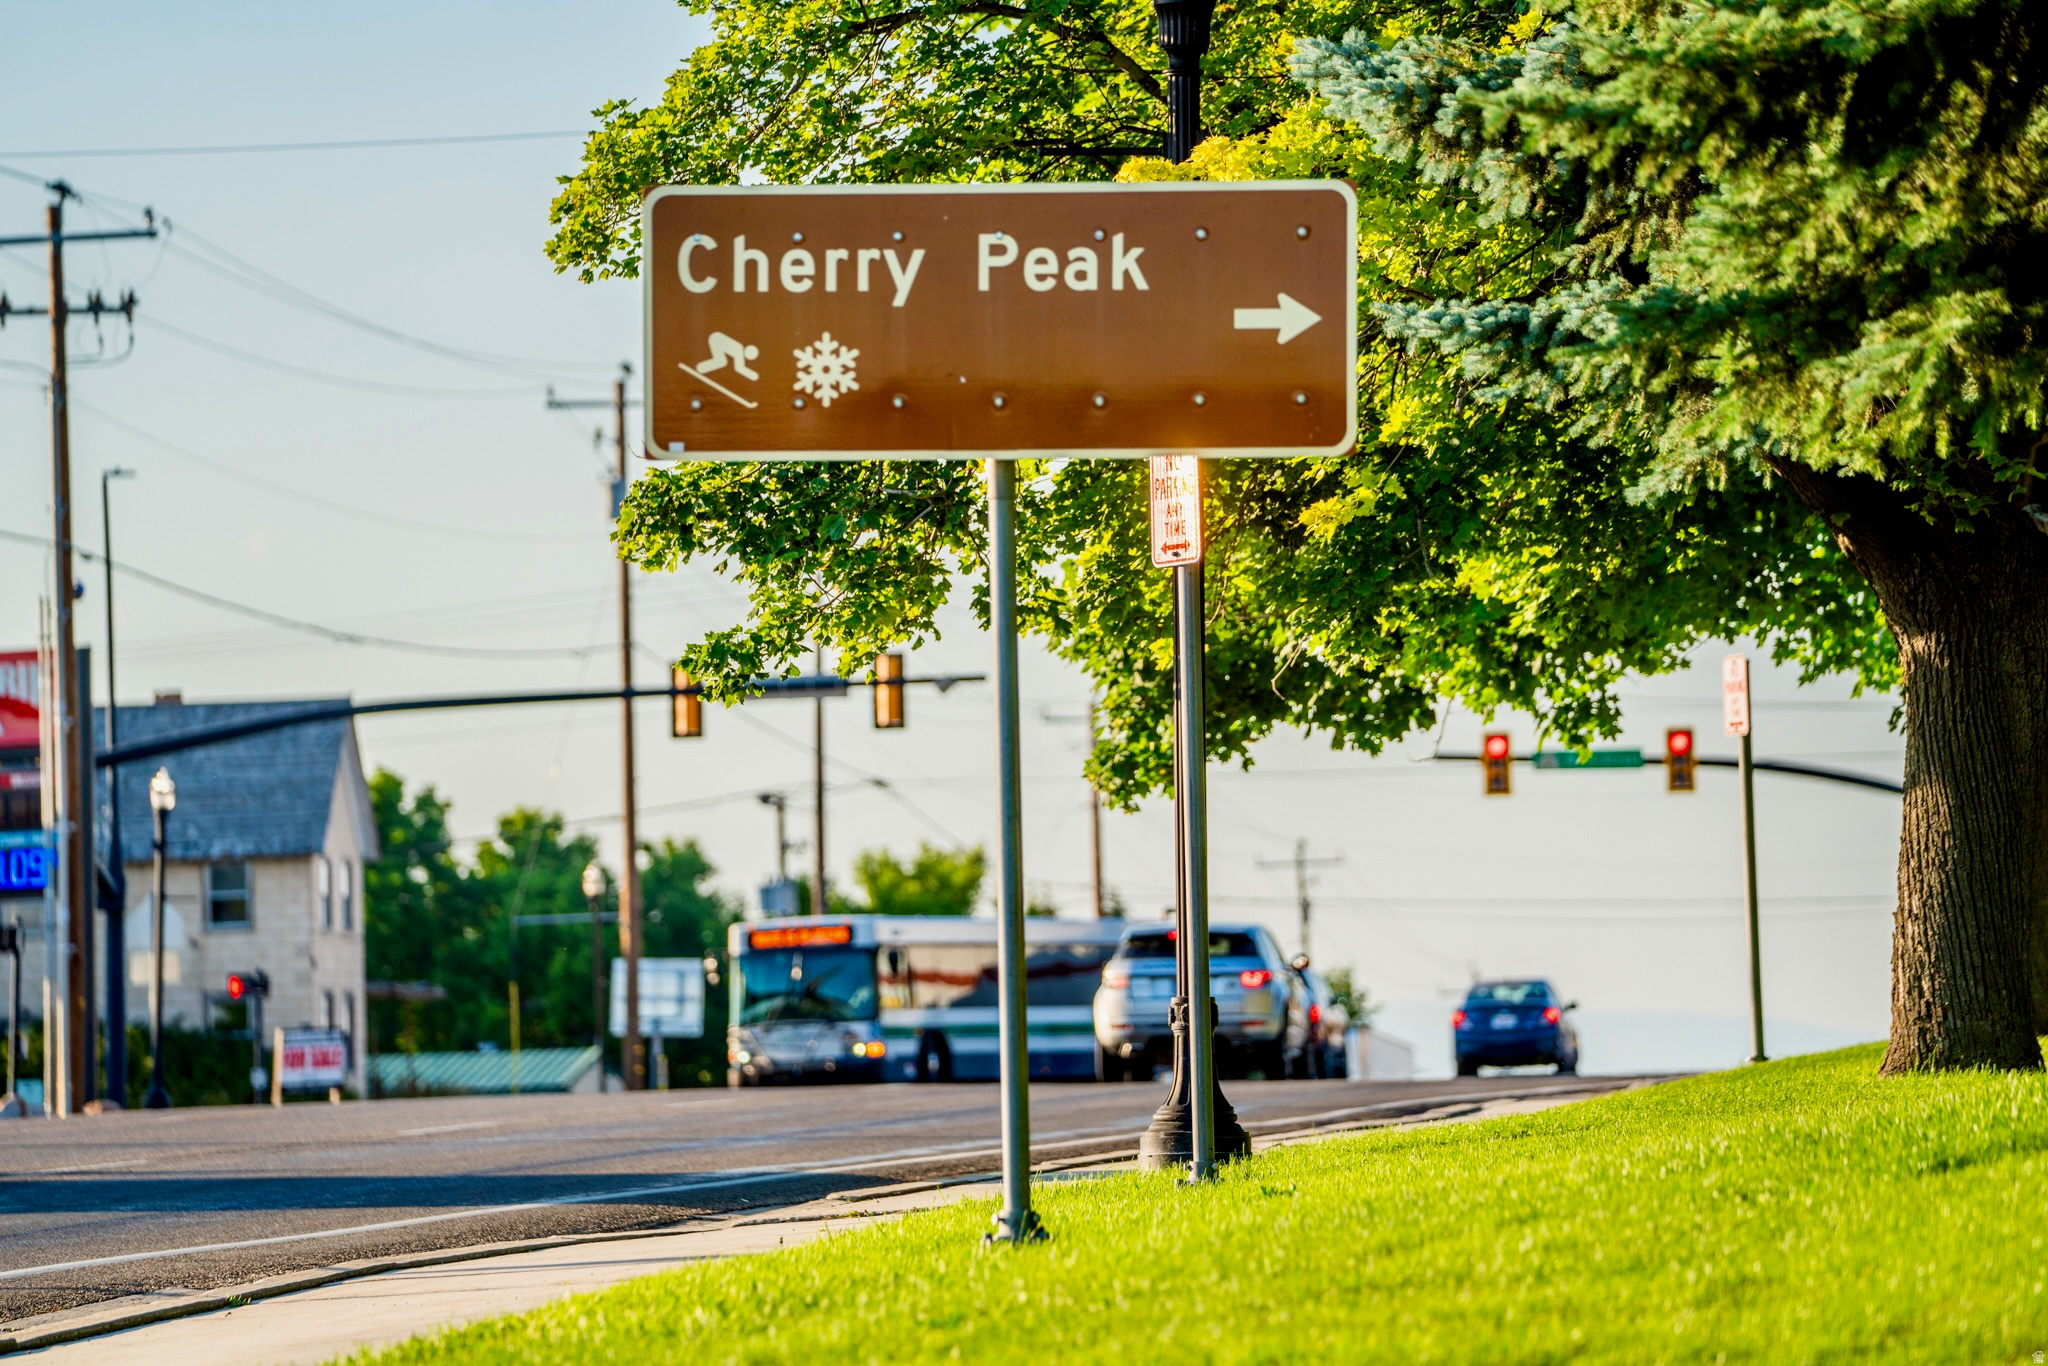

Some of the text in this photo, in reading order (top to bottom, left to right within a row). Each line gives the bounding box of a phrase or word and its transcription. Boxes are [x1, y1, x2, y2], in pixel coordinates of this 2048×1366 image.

[677, 233, 1150, 307] Cherry Peak
[1165, 520, 1186, 537] TIME
